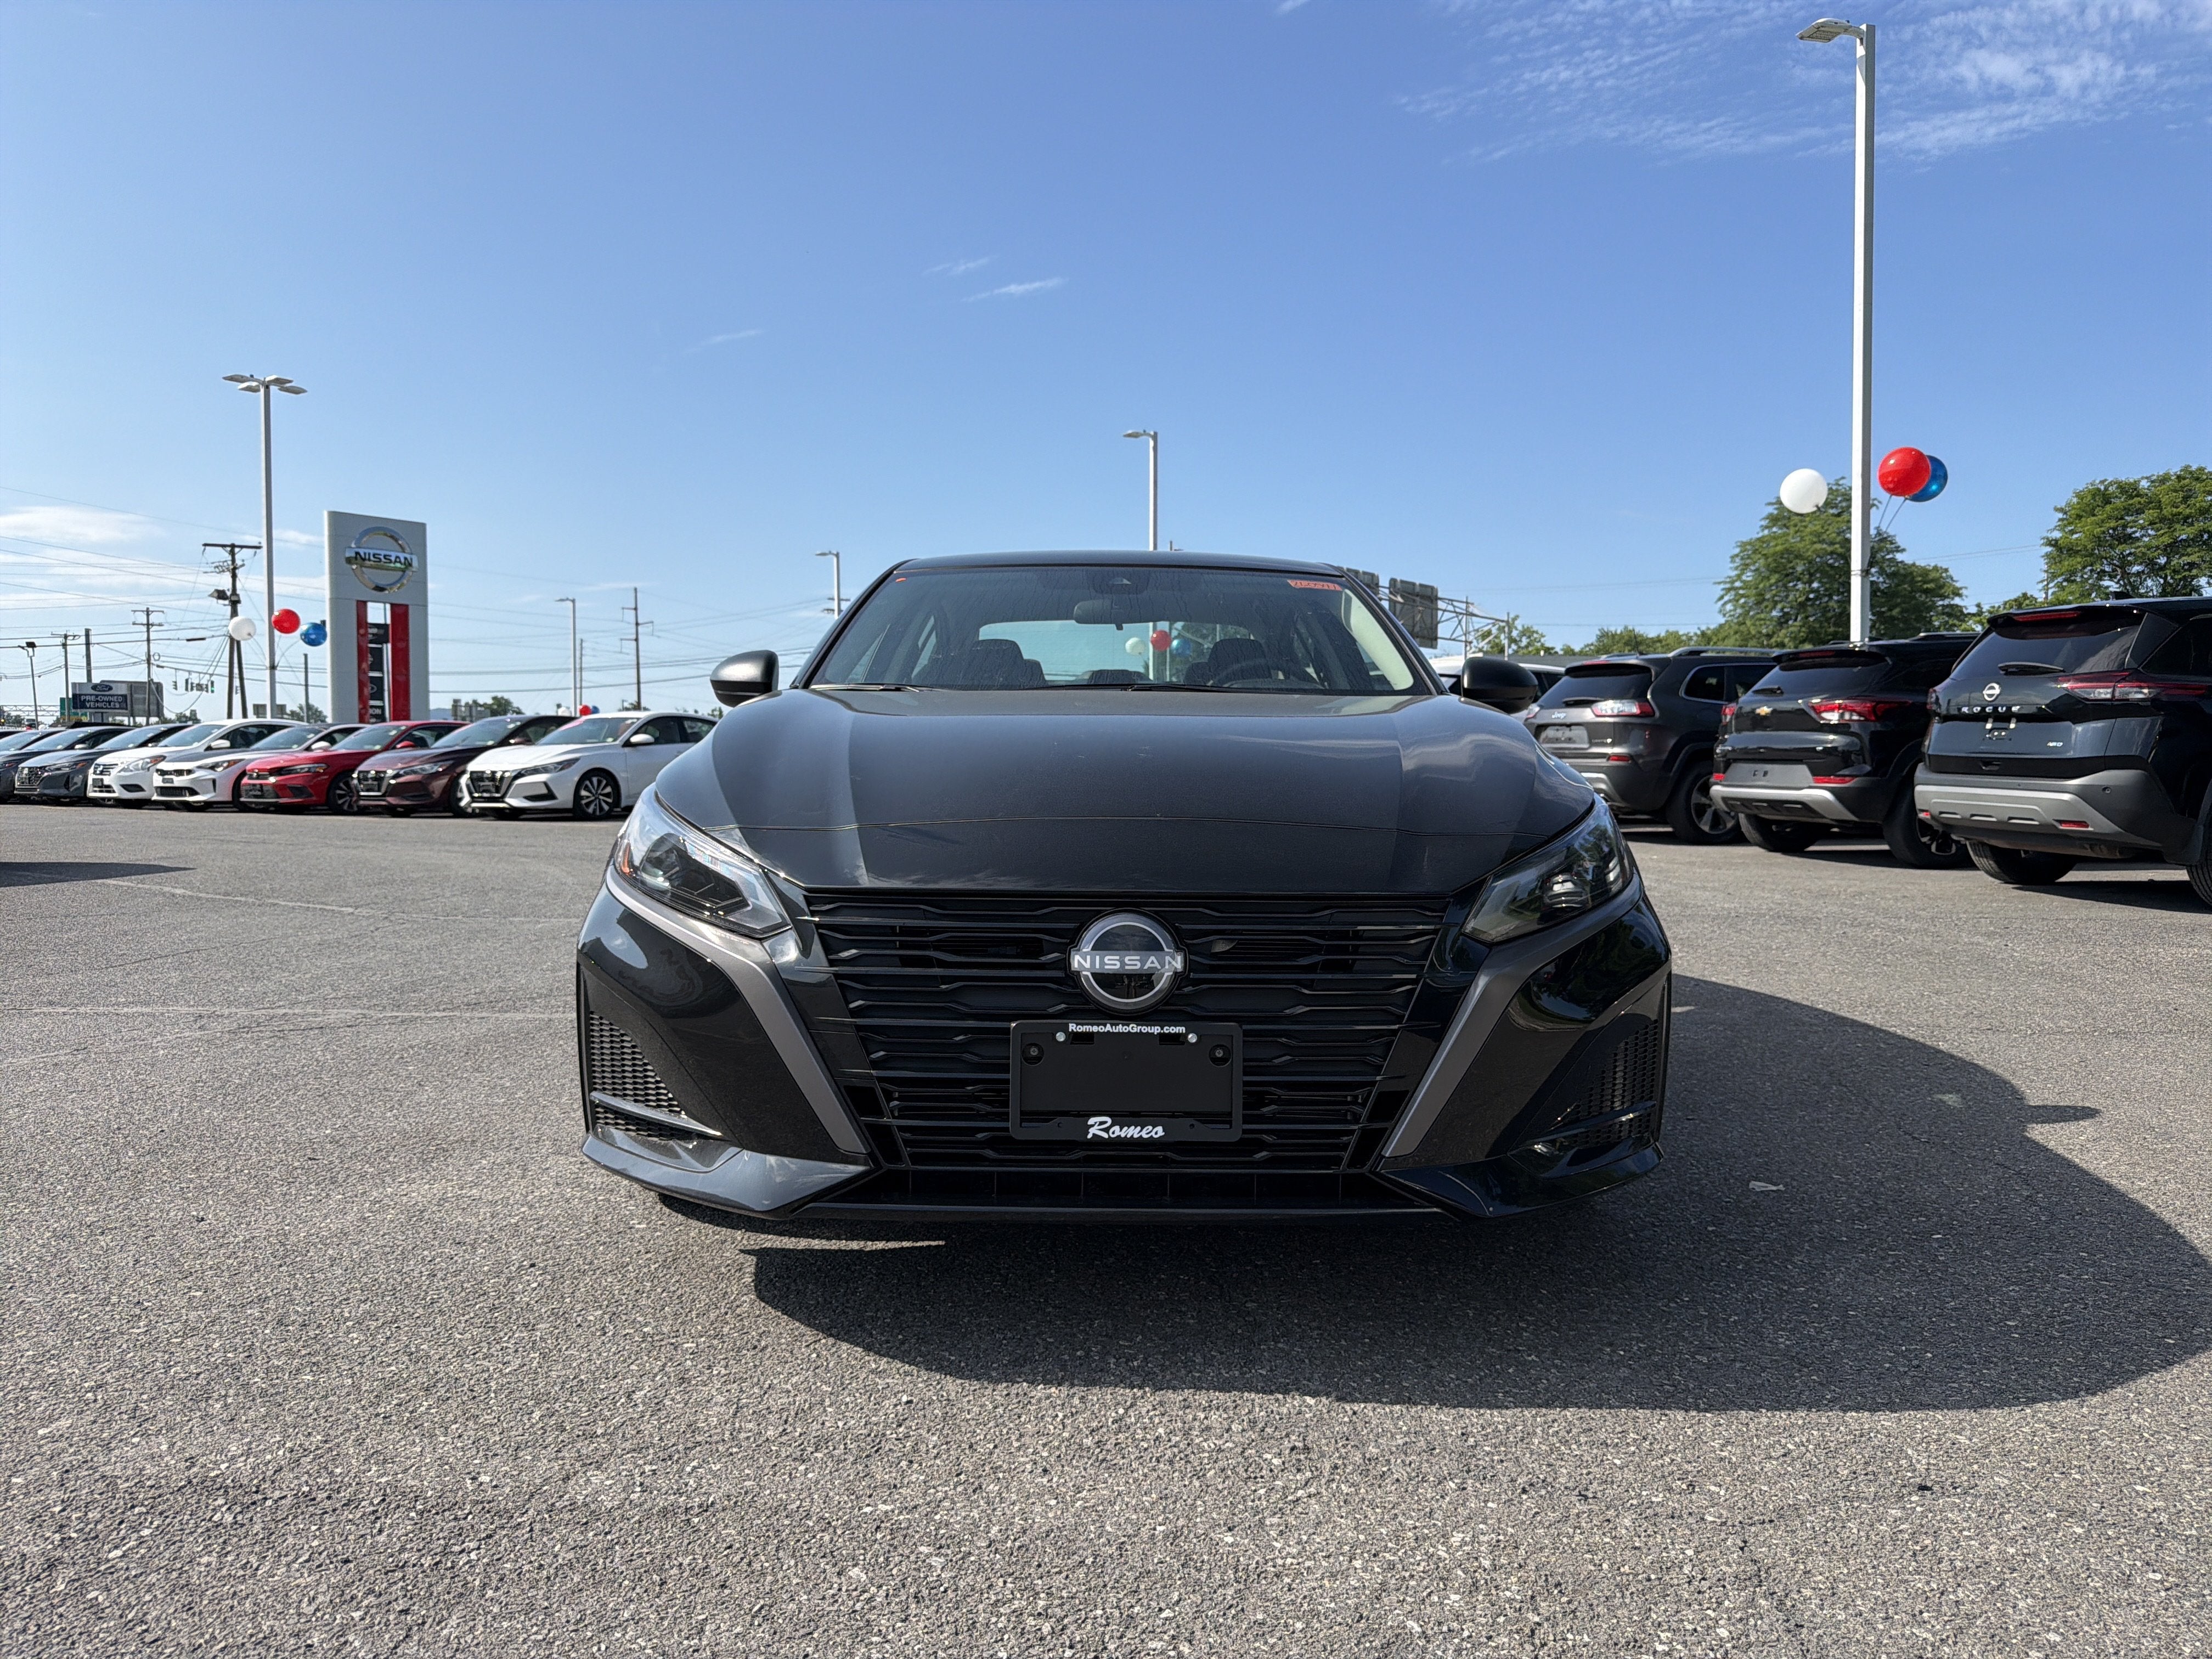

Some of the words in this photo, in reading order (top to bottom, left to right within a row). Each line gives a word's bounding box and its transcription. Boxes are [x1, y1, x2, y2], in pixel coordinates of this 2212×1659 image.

[354, 551, 413, 567] NISSAN
[1074, 955, 1182, 970] NISSAN
[1068, 1023, 1186, 1035] RomeoAutoGroup.com
[1086, 1116, 1165, 1139] Romeo
